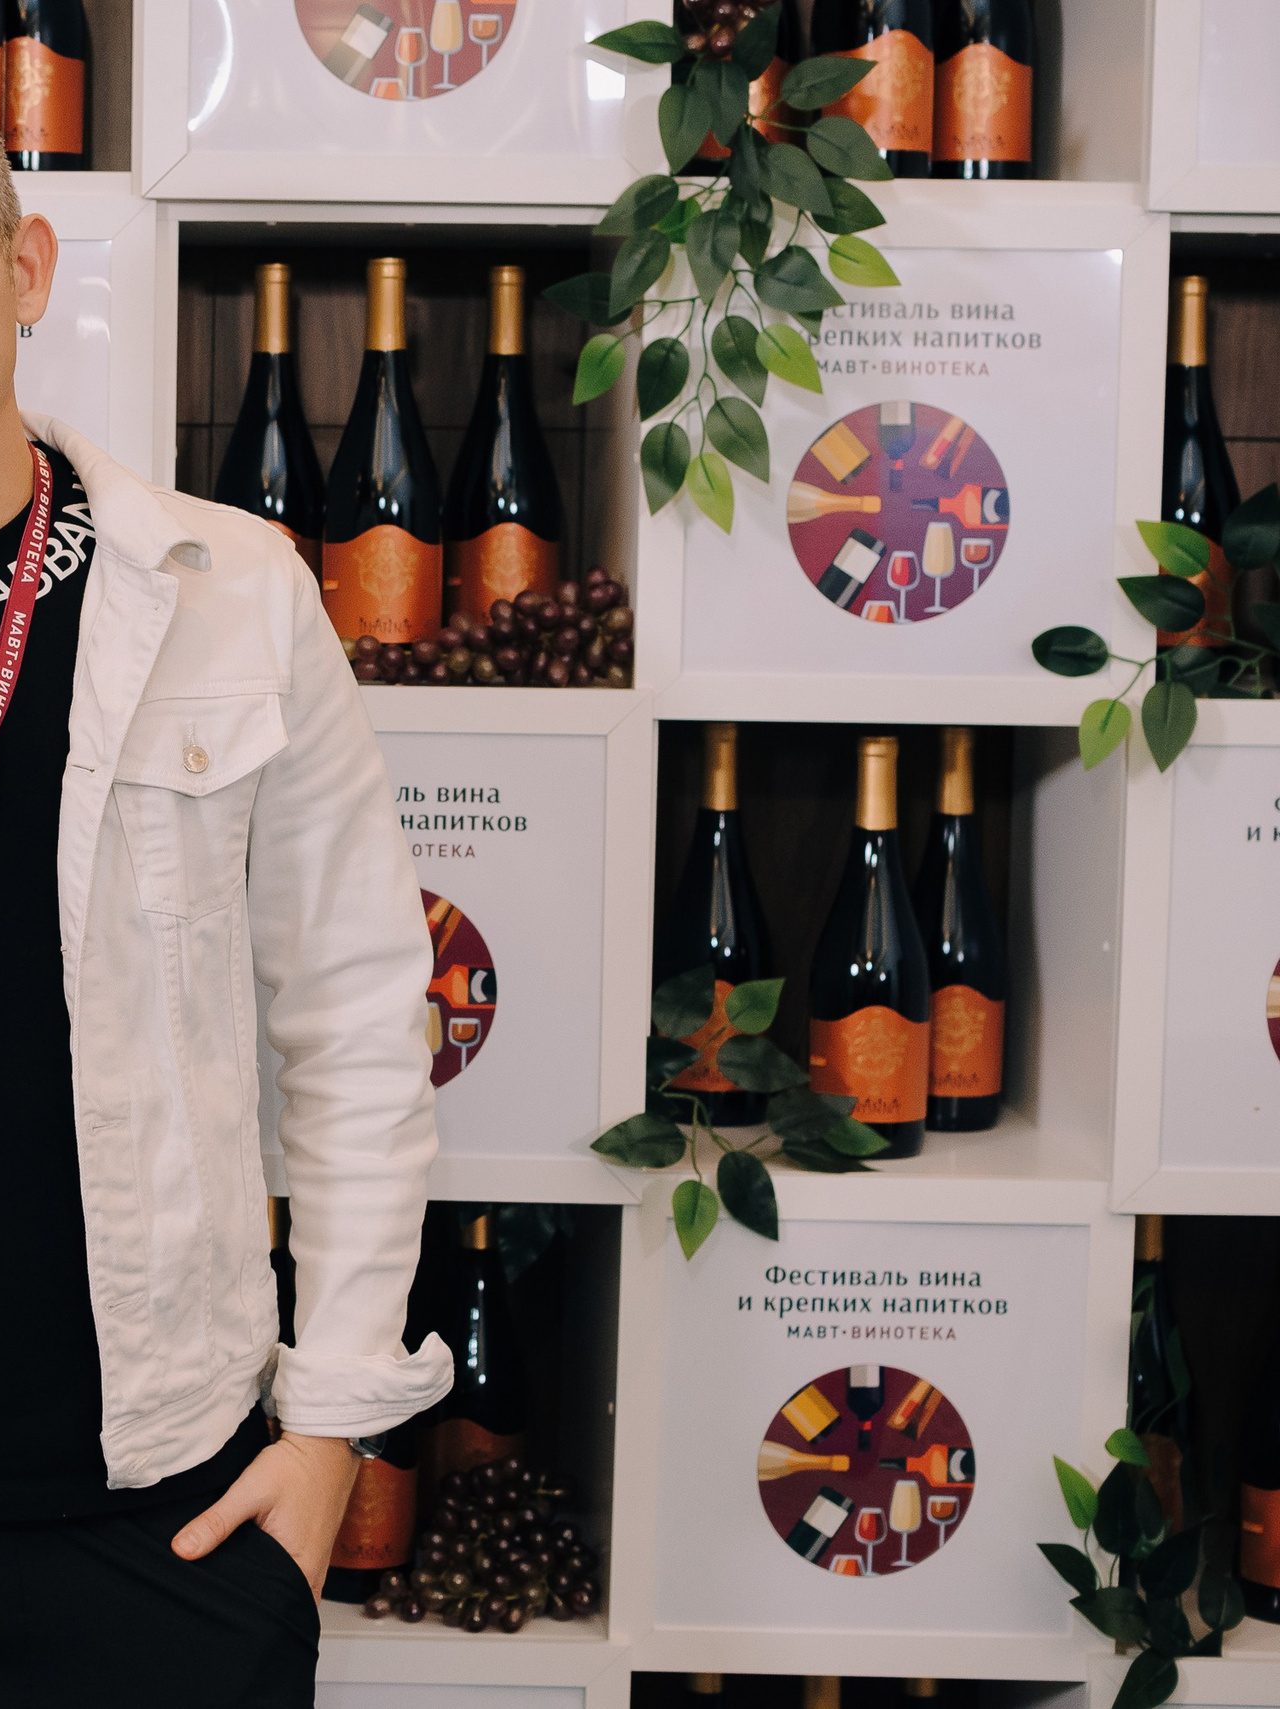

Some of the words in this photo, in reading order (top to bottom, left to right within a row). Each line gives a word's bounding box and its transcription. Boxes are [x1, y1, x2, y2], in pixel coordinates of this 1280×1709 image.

[824, 302, 939, 320] стиваль
[950, 303, 1015, 321] вина
[913, 331, 1042, 350] напитков
[437, 787, 501, 804] вина
[400, 814, 528, 832] напитков
[1247, 826, 1261, 842] и
[765, 1265, 908, 1287] Фестиваль
[919, 1271, 982, 1288] вина
[738, 1295, 752, 1311] и
[764, 1296, 872, 1319] крепких
[882, 1297, 1008, 1315] напитков
